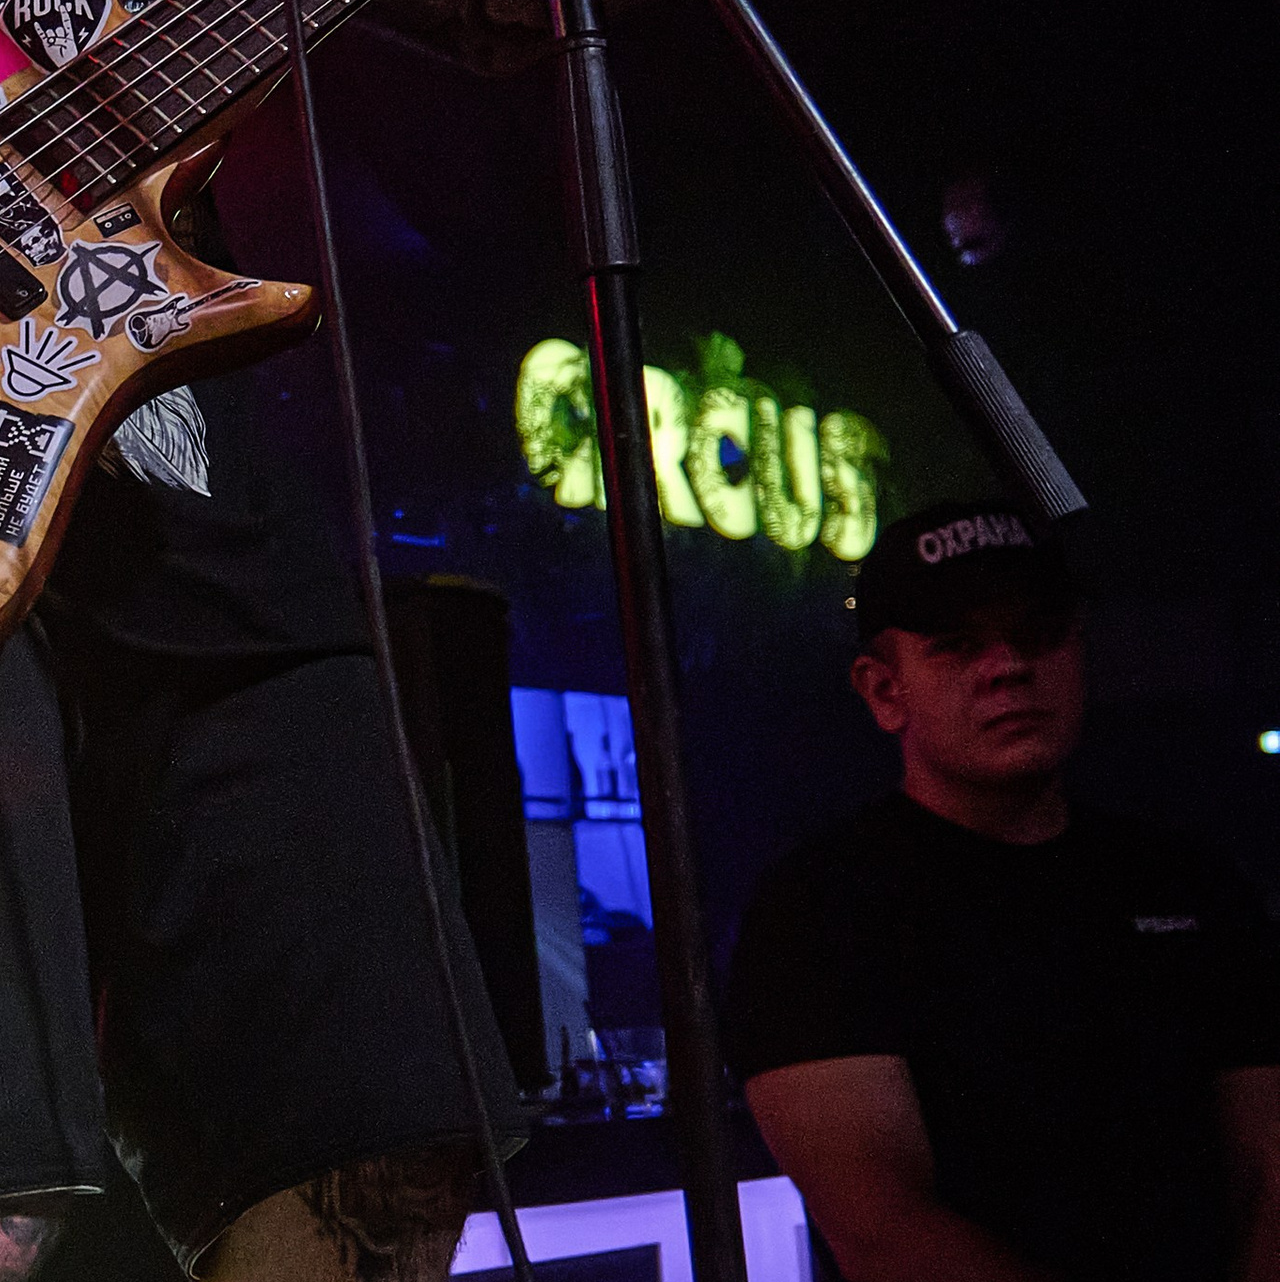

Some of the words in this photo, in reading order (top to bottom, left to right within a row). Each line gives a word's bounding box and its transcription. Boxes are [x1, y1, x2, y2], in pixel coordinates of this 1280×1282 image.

[6, 515, 24, 537] НЕ
[16, 463, 46, 514] БУДЕТ
[515, 337, 887, 561] CRCUS
